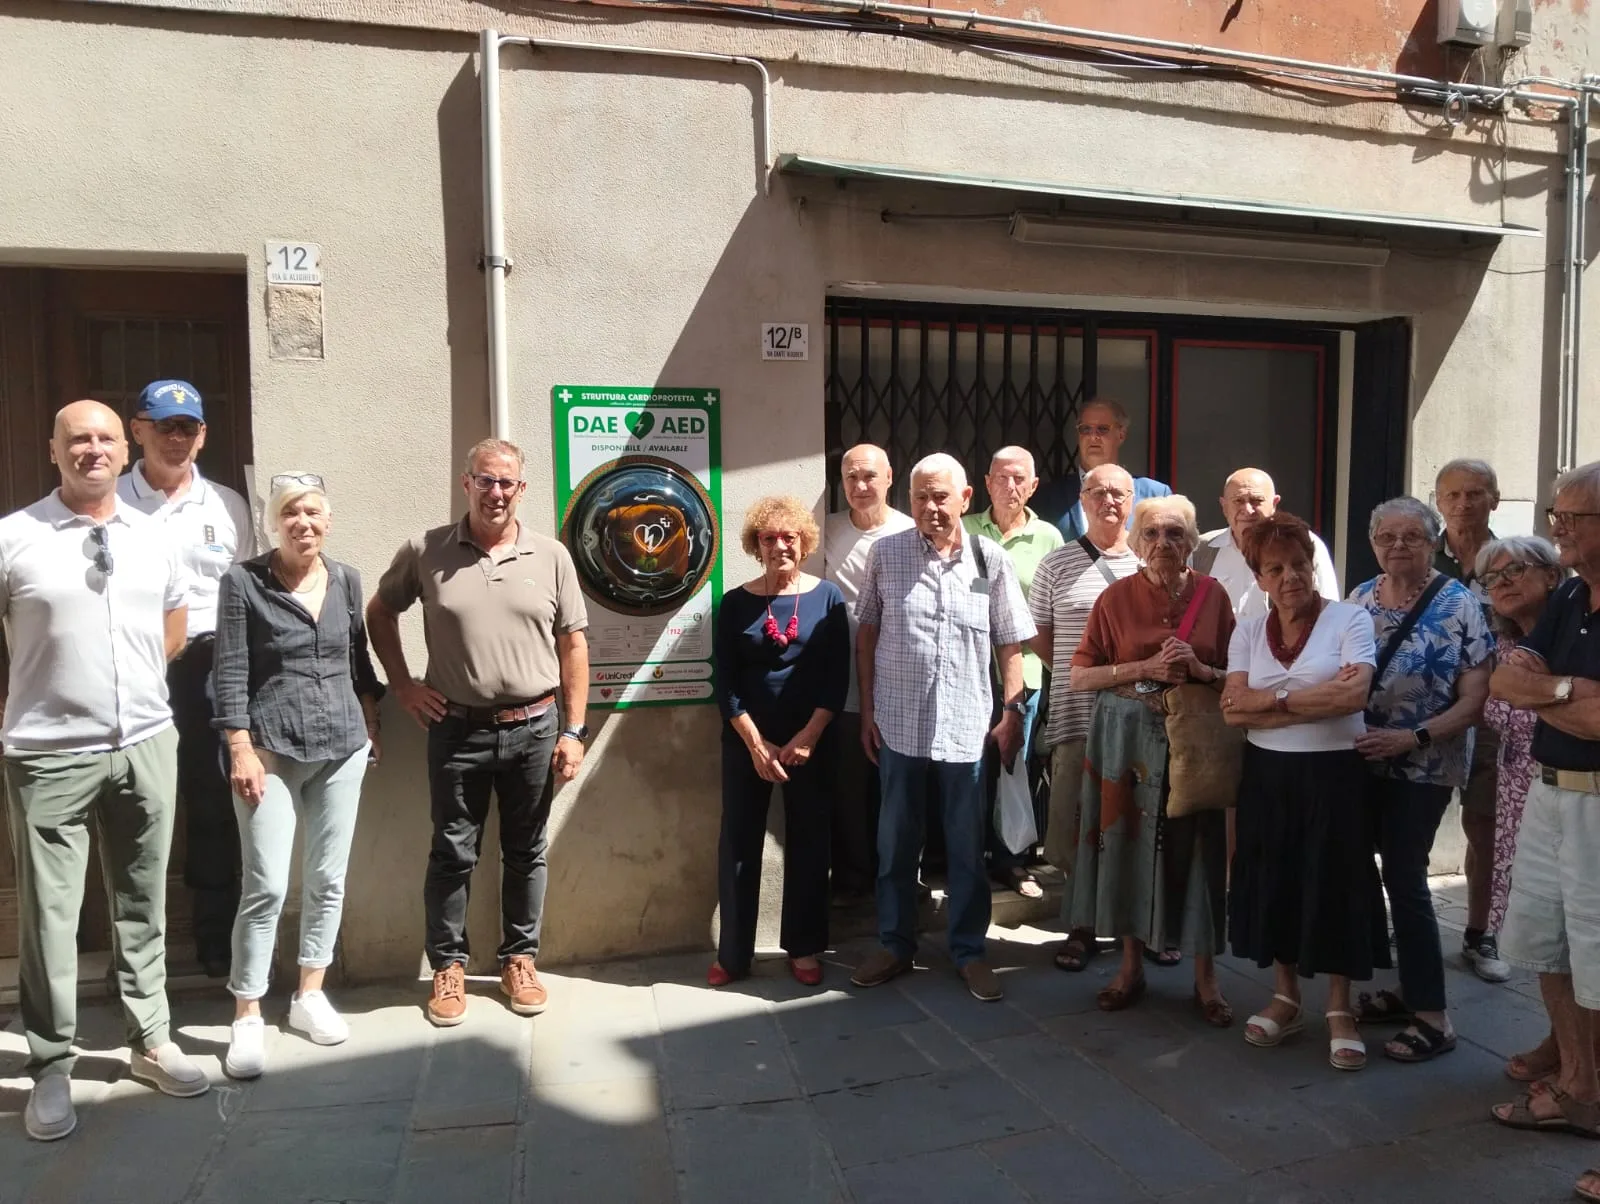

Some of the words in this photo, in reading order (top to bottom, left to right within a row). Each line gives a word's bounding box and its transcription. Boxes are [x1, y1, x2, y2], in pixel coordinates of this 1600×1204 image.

[278, 245, 308, 270] 12
[581, 392, 627, 401] STRUTTURA
[627, 393, 696, 402] CARDIOPROTETTA
[573, 415, 618, 433] DAE
[660, 416, 706, 434] AED
[591, 444, 641, 452] DISPONIBILE
[604, 671, 636, 680] UniCredit
